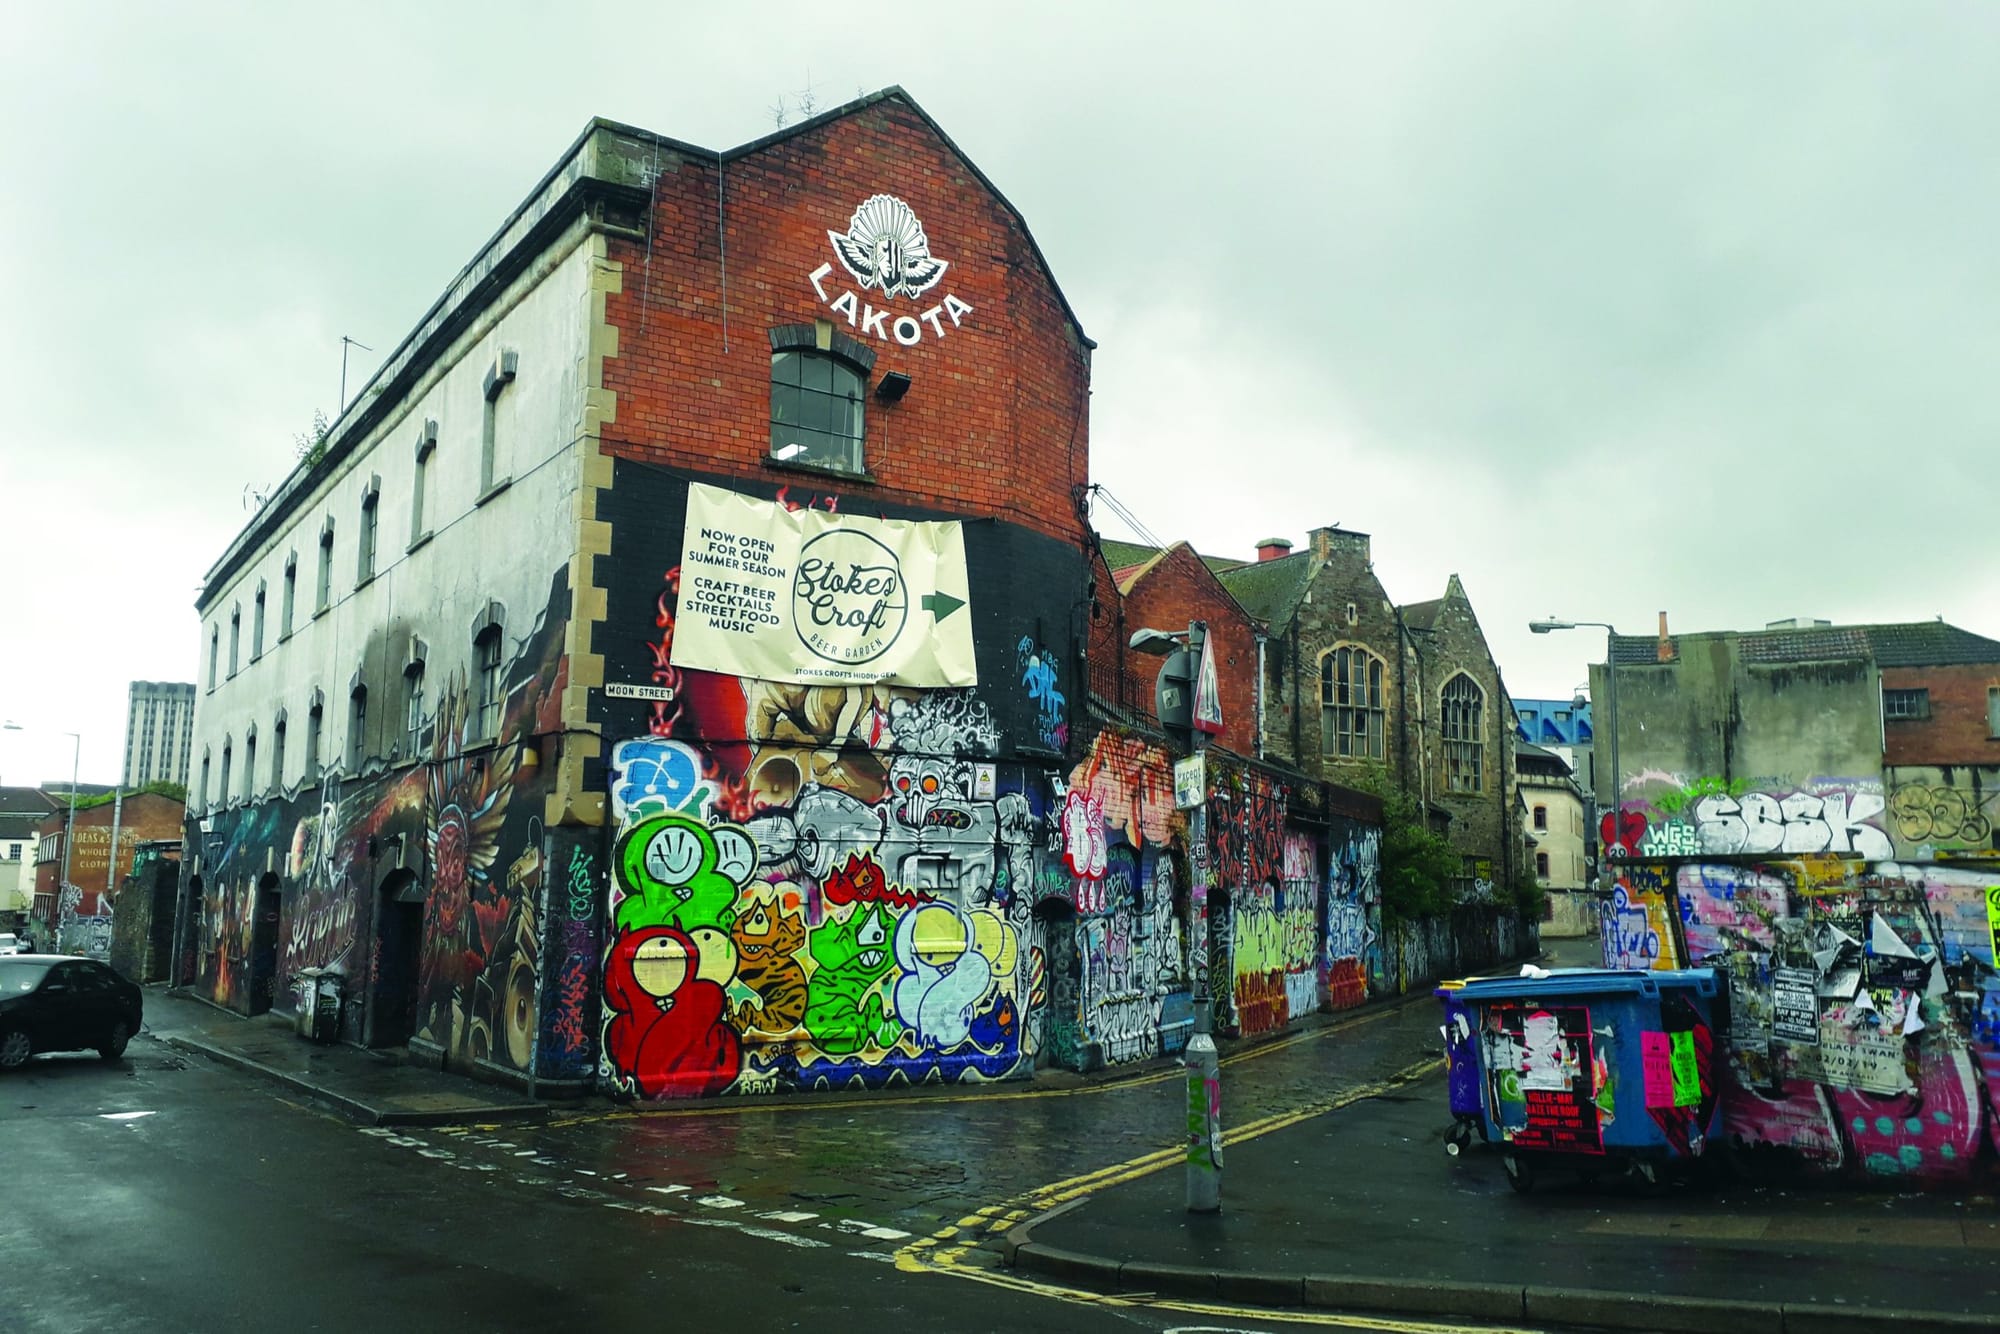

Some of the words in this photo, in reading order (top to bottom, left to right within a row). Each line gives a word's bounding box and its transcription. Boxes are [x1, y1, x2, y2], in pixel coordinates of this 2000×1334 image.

[808, 262, 975, 346] LAKOTA
[701, 528, 735, 544] NOW
[739, 536, 775, 553] OPEN
[708, 541, 736, 557] FOR
[740, 548, 769, 564] OUR
[688, 551, 740, 571] SUMMER
[742, 561, 786, 579] SEASON
[694, 577, 739, 594] CRAFT
[743, 585, 775, 601] BEER
[797, 558, 897, 606] Stokes
[686, 600, 736, 618] STREET
[739, 608, 780, 626] FOOD
[696, 590, 772, 613] COCKTAILS
[709, 618, 755, 634] MUSIC
[807, 594, 905, 637] Croft
[810, 632, 838, 656] BEER
[845, 637, 884, 659] GARDEN
[795, 668, 823, 677] STOKES
[608, 686, 634, 696] MOON
[639, 689, 672, 699] STREET
